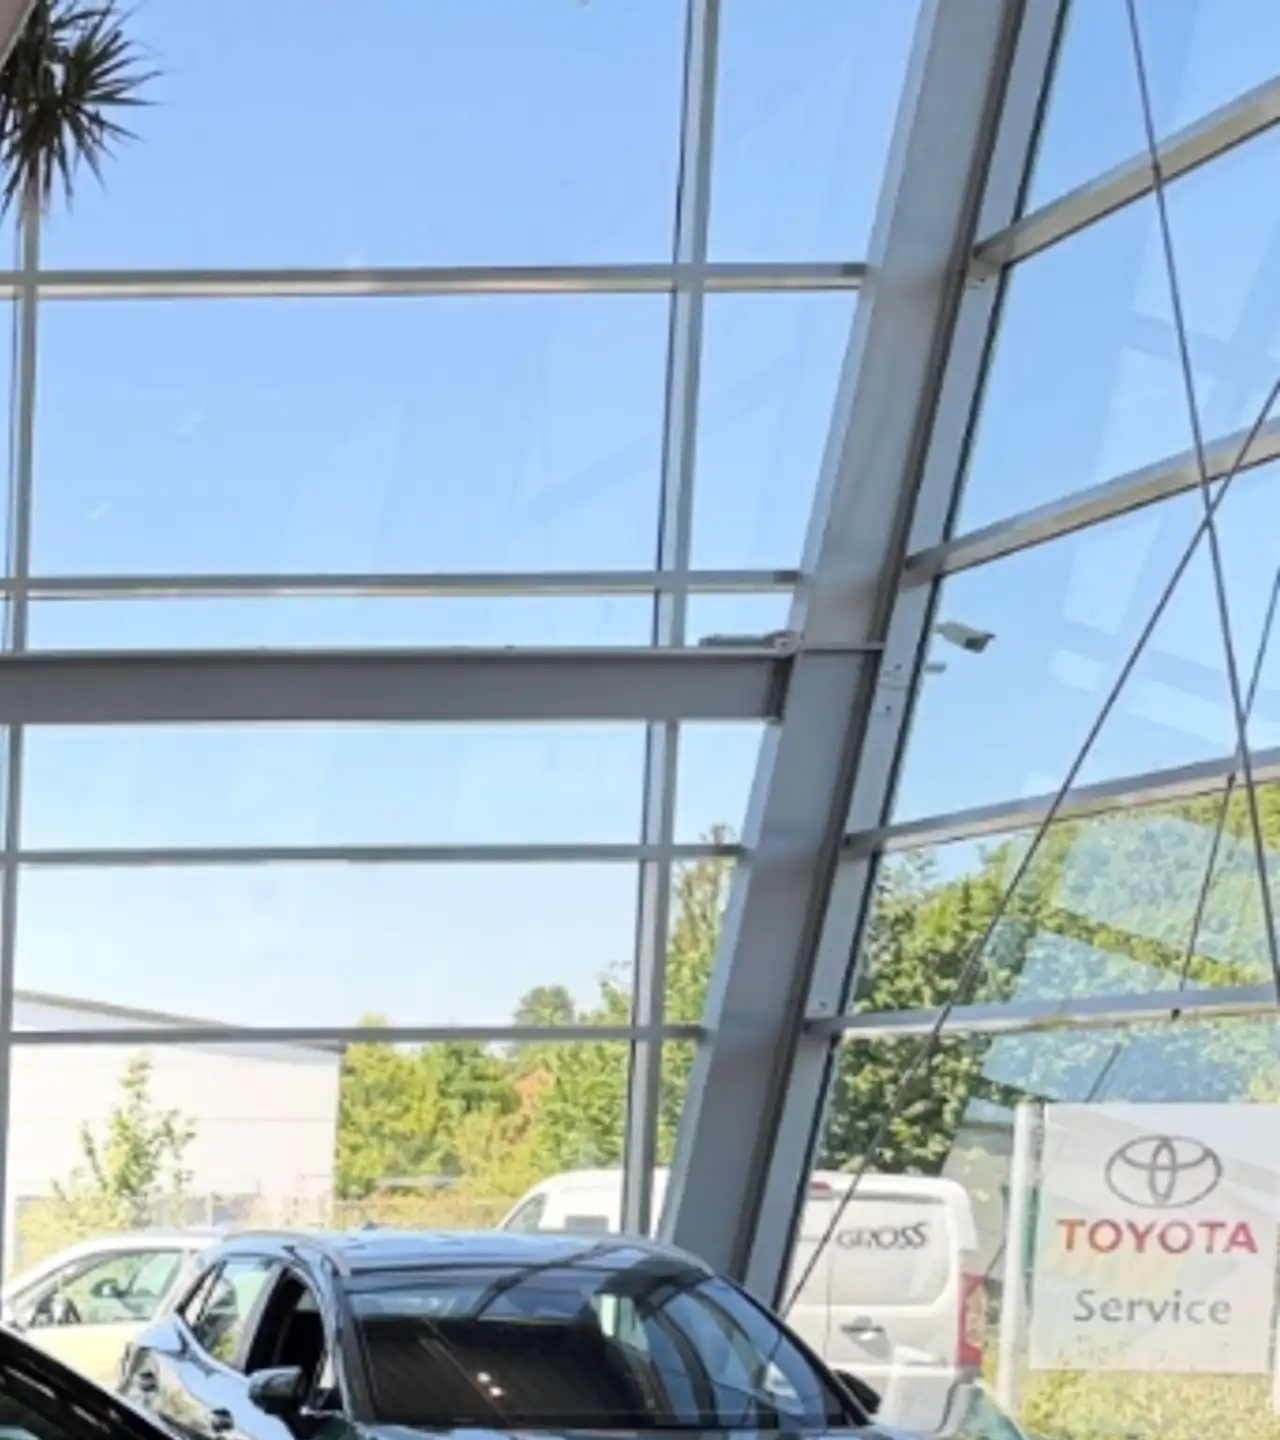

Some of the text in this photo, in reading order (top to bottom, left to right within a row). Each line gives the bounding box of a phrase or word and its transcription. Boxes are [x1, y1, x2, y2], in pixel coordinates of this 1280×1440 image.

[837, 1221, 929, 1250] GROSS
[1056, 1218, 1259, 1255] TOYOTA
[1073, 1288, 1233, 1326] Service
